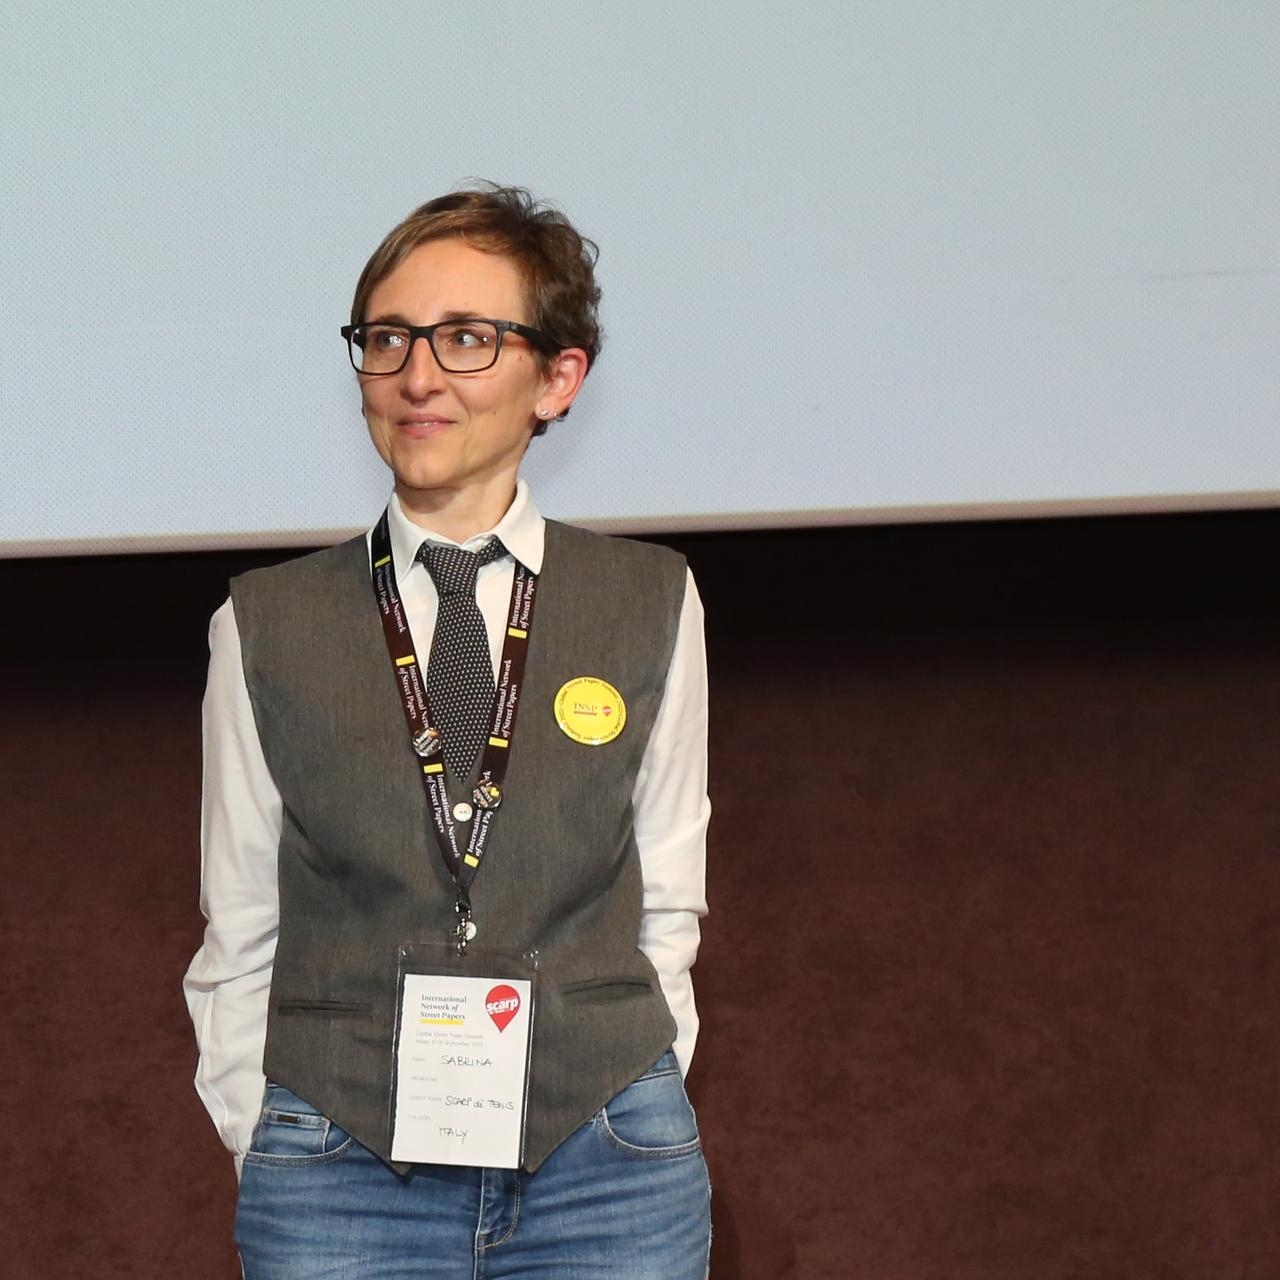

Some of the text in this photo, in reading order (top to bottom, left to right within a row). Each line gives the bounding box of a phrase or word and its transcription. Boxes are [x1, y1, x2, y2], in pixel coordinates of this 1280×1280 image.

[524, 576, 534, 601] Papers
[510, 579, 524, 627] International
[522, 601, 531, 620] Street
[391, 602, 406, 633] Network
[400, 672, 410, 696] Street
[405, 693, 417, 720] Papers
[409, 665, 424, 711] International
[492, 659, 512, 735] International Network
[507, 684, 518, 710] Papers
[504, 709, 513, 729] Street
[428, 782, 438, 806] Street
[434, 805, 445, 833] Papers
[437, 774, 461, 858] International Network
[467, 809, 482, 853] Internation
[477, 825, 488, 847] Street
[421, 994, 467, 1003] International
[451, 1003, 459, 1011] of
[486, 998, 518, 1012] scarp
[420, 1011, 466, 1021] Street Papers
[439, 1127, 469, 1144] ITALY
